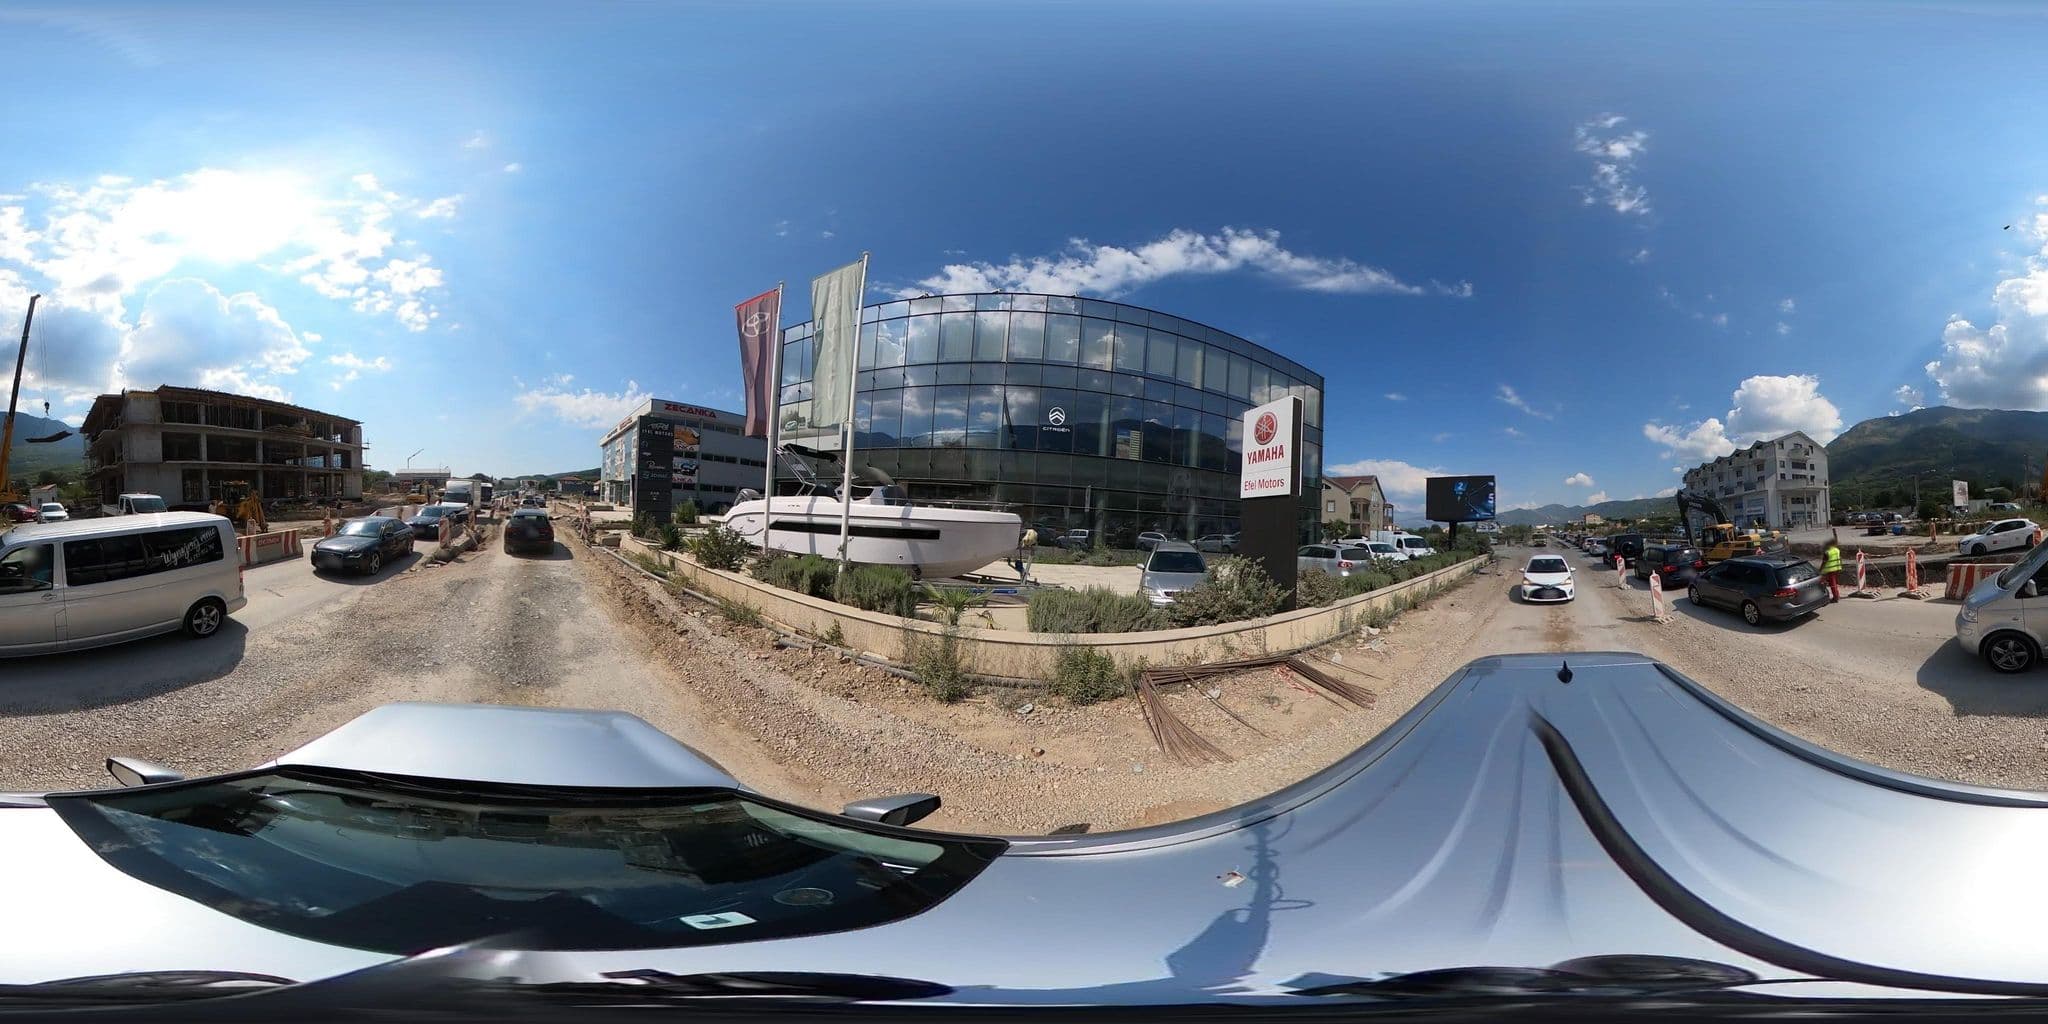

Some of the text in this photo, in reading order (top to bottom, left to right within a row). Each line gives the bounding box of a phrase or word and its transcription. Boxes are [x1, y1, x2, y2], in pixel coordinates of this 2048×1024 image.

[1247, 445, 1285, 465] YAMAHA
[1244, 478, 1285, 491] Efel Motors
